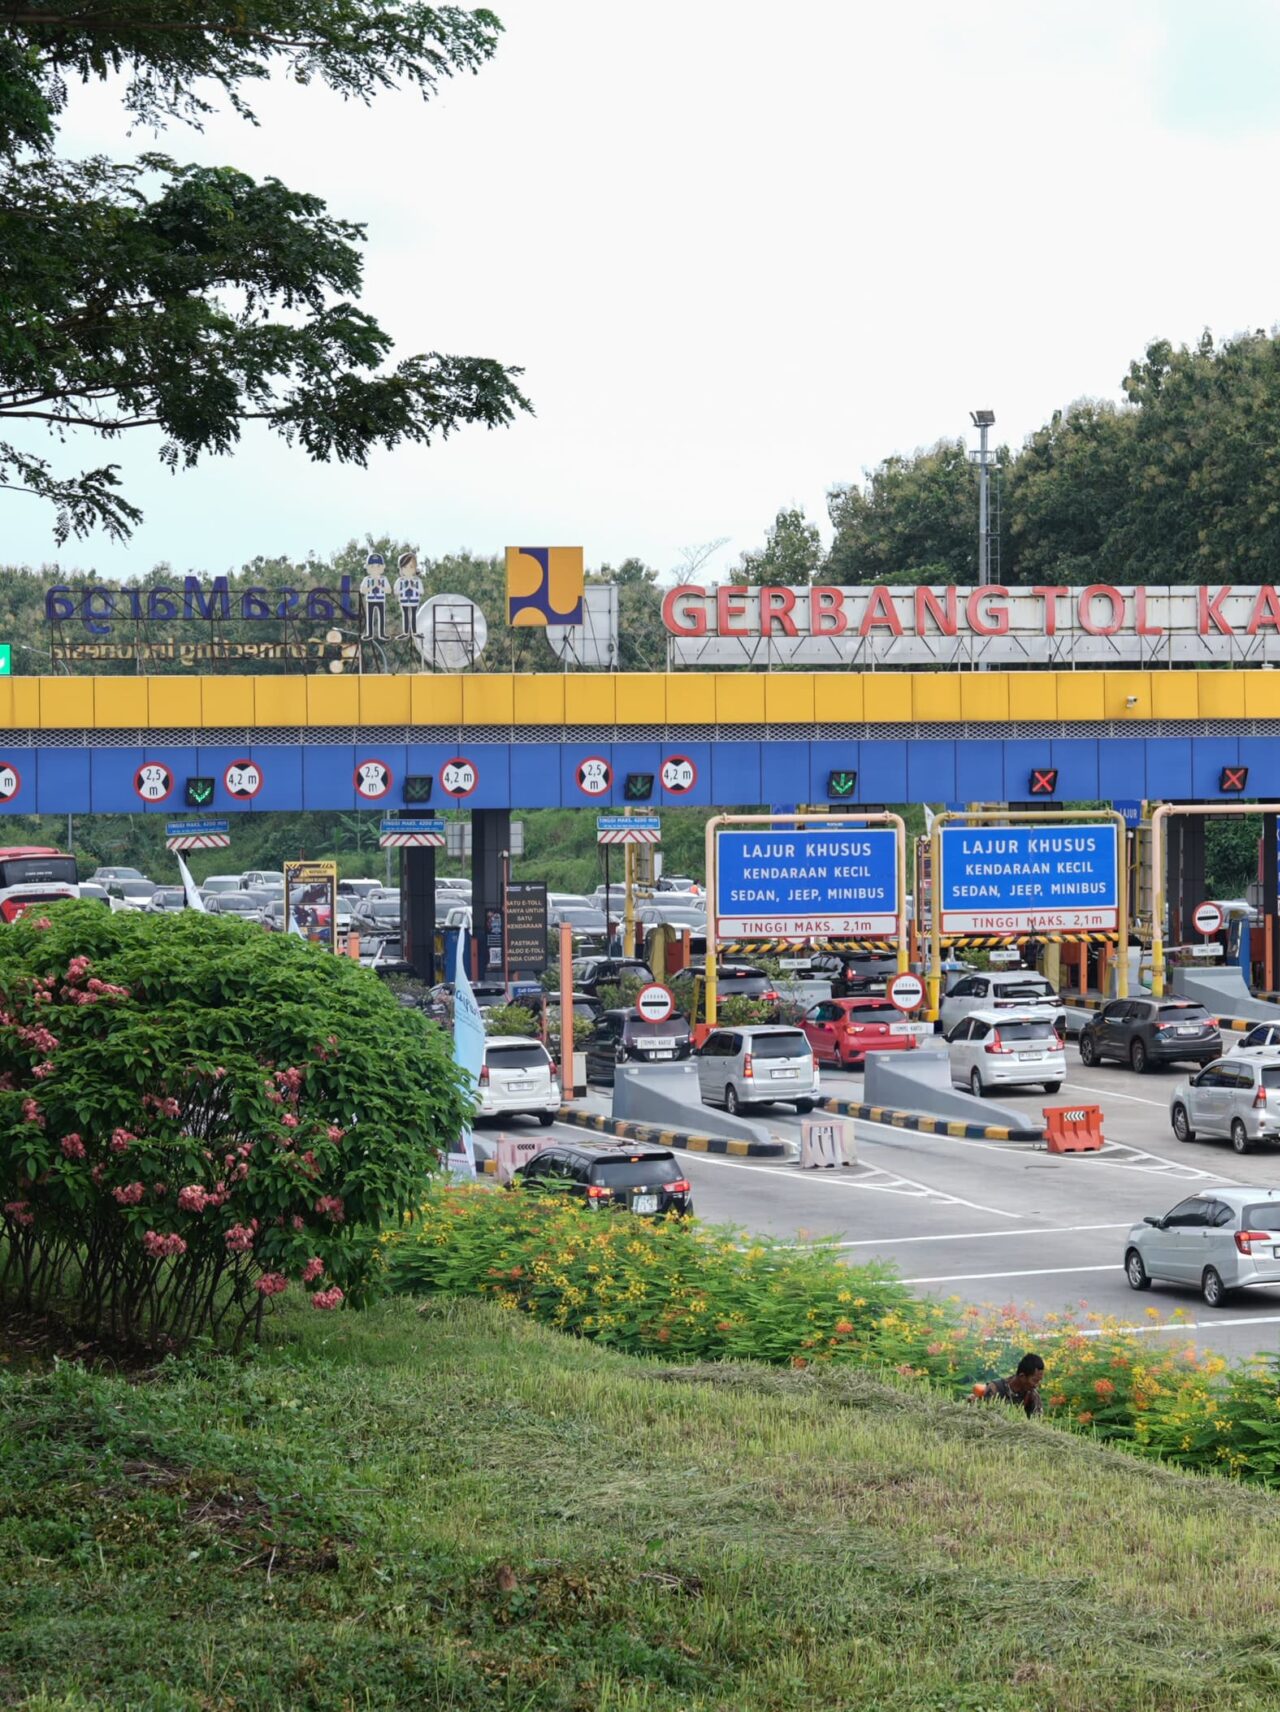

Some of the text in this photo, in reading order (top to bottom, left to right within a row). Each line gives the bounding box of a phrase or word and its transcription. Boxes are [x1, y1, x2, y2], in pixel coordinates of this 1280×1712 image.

[661, 583, 1011, 638] GERBANG
[1032, 583, 1164, 637] TOL
[146, 768, 161, 781] 2,5
[365, 766, 379, 779] 2,5
[588, 764, 602, 777] 2,5
[664, 768, 691, 781] 4,2 m
[228, 773, 257, 786] 4,2 m
[444, 771, 472, 784] 4,2 m
[149, 786, 158, 795] m
[368, 783, 378, 792] m
[590, 780, 599, 790] m
[743, 843, 872, 858] LAJUR KHUSUS
[963, 838, 1096, 854] LAJUR KHUSUS
[743, 866, 871, 879] KENDARAAN KECIL
[966, 861, 1093, 876] KENDARAAN KECIL
[730, 887, 884, 902] SEDAN, JEEP, MINIBUS
[952, 882, 1107, 898] SEDAN, JEEP, MINIBUS
[742, 922, 788, 933] TINGGI
[794, 921, 834, 932] MAKS.
[972, 917, 1019, 928] TINGGI
[1027, 916, 1066, 927] MAKS.
